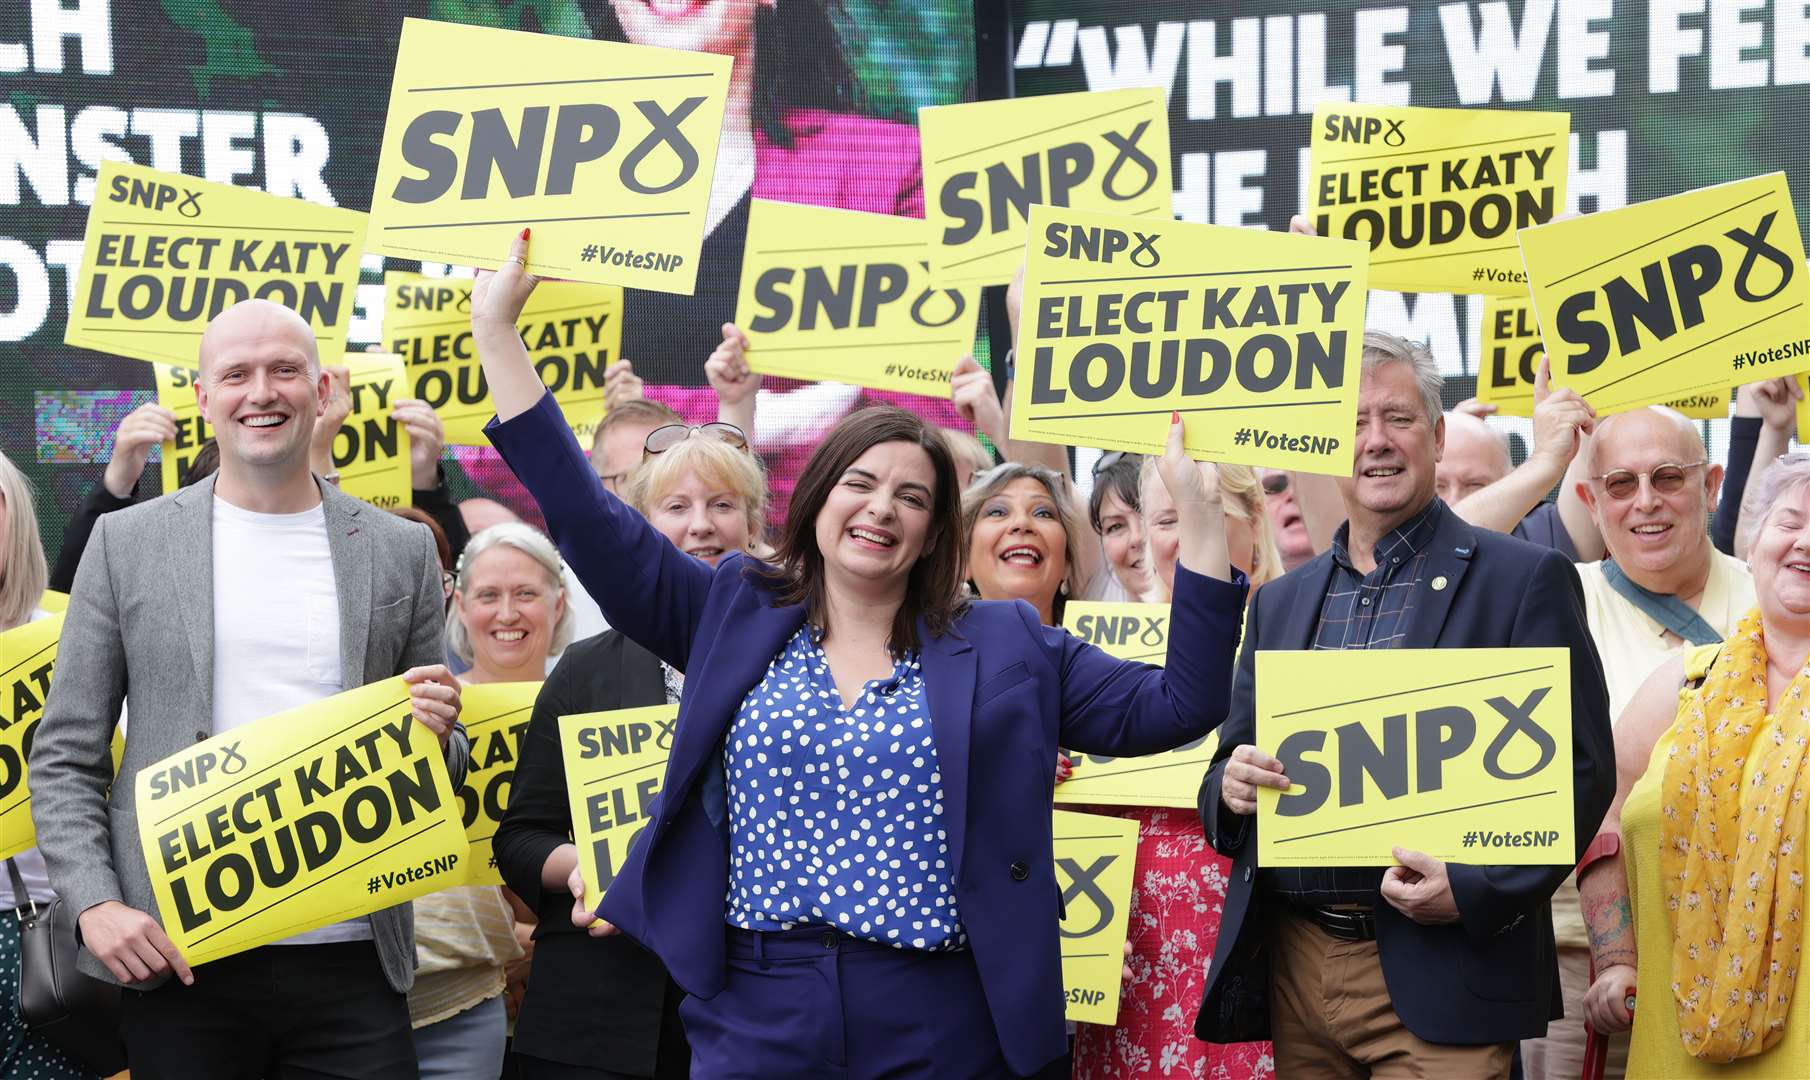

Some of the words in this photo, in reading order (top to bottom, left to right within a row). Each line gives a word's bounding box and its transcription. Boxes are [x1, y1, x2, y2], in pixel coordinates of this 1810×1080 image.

[1440, 0, 1616, 105] WE
[1324, 114, 1382, 144] SNP
[392, 103, 621, 204] SNP
[1318, 163, 1429, 207] ELECT
[1441, 146, 1555, 193] KATY
[108, 174, 178, 212] SNP
[939, 142, 1095, 246] SNP
[95, 234, 221, 271] ELECT
[229, 239, 351, 275] KATY
[580, 244, 684, 273] #VoteSNP
[1043, 222, 1129, 264] SNP
[396, 284, 454, 312] SNP
[748, 262, 909, 333] SNP
[1036, 290, 1189, 339] ELECT
[1202, 281, 1351, 330] KATY
[1556, 244, 1723, 375] SNP
[393, 331, 472, 368] ELEC
[1030, 330, 1348, 405] LOUDON
[1234, 428, 1340, 456] #VoteSNP
[1076, 615, 1140, 645] SNP
[577, 721, 652, 759] SNP
[1275, 705, 1477, 817] SNP
[150, 752, 218, 800] SNP
[158, 778, 282, 875] ELECT
[295, 712, 414, 807] KATY
[586, 777, 660, 834] ELE
[170, 756, 442, 934] LOUDON
[1462, 831, 1560, 848] #VoteSNP
[367, 854, 458, 894] #VoteSNP
